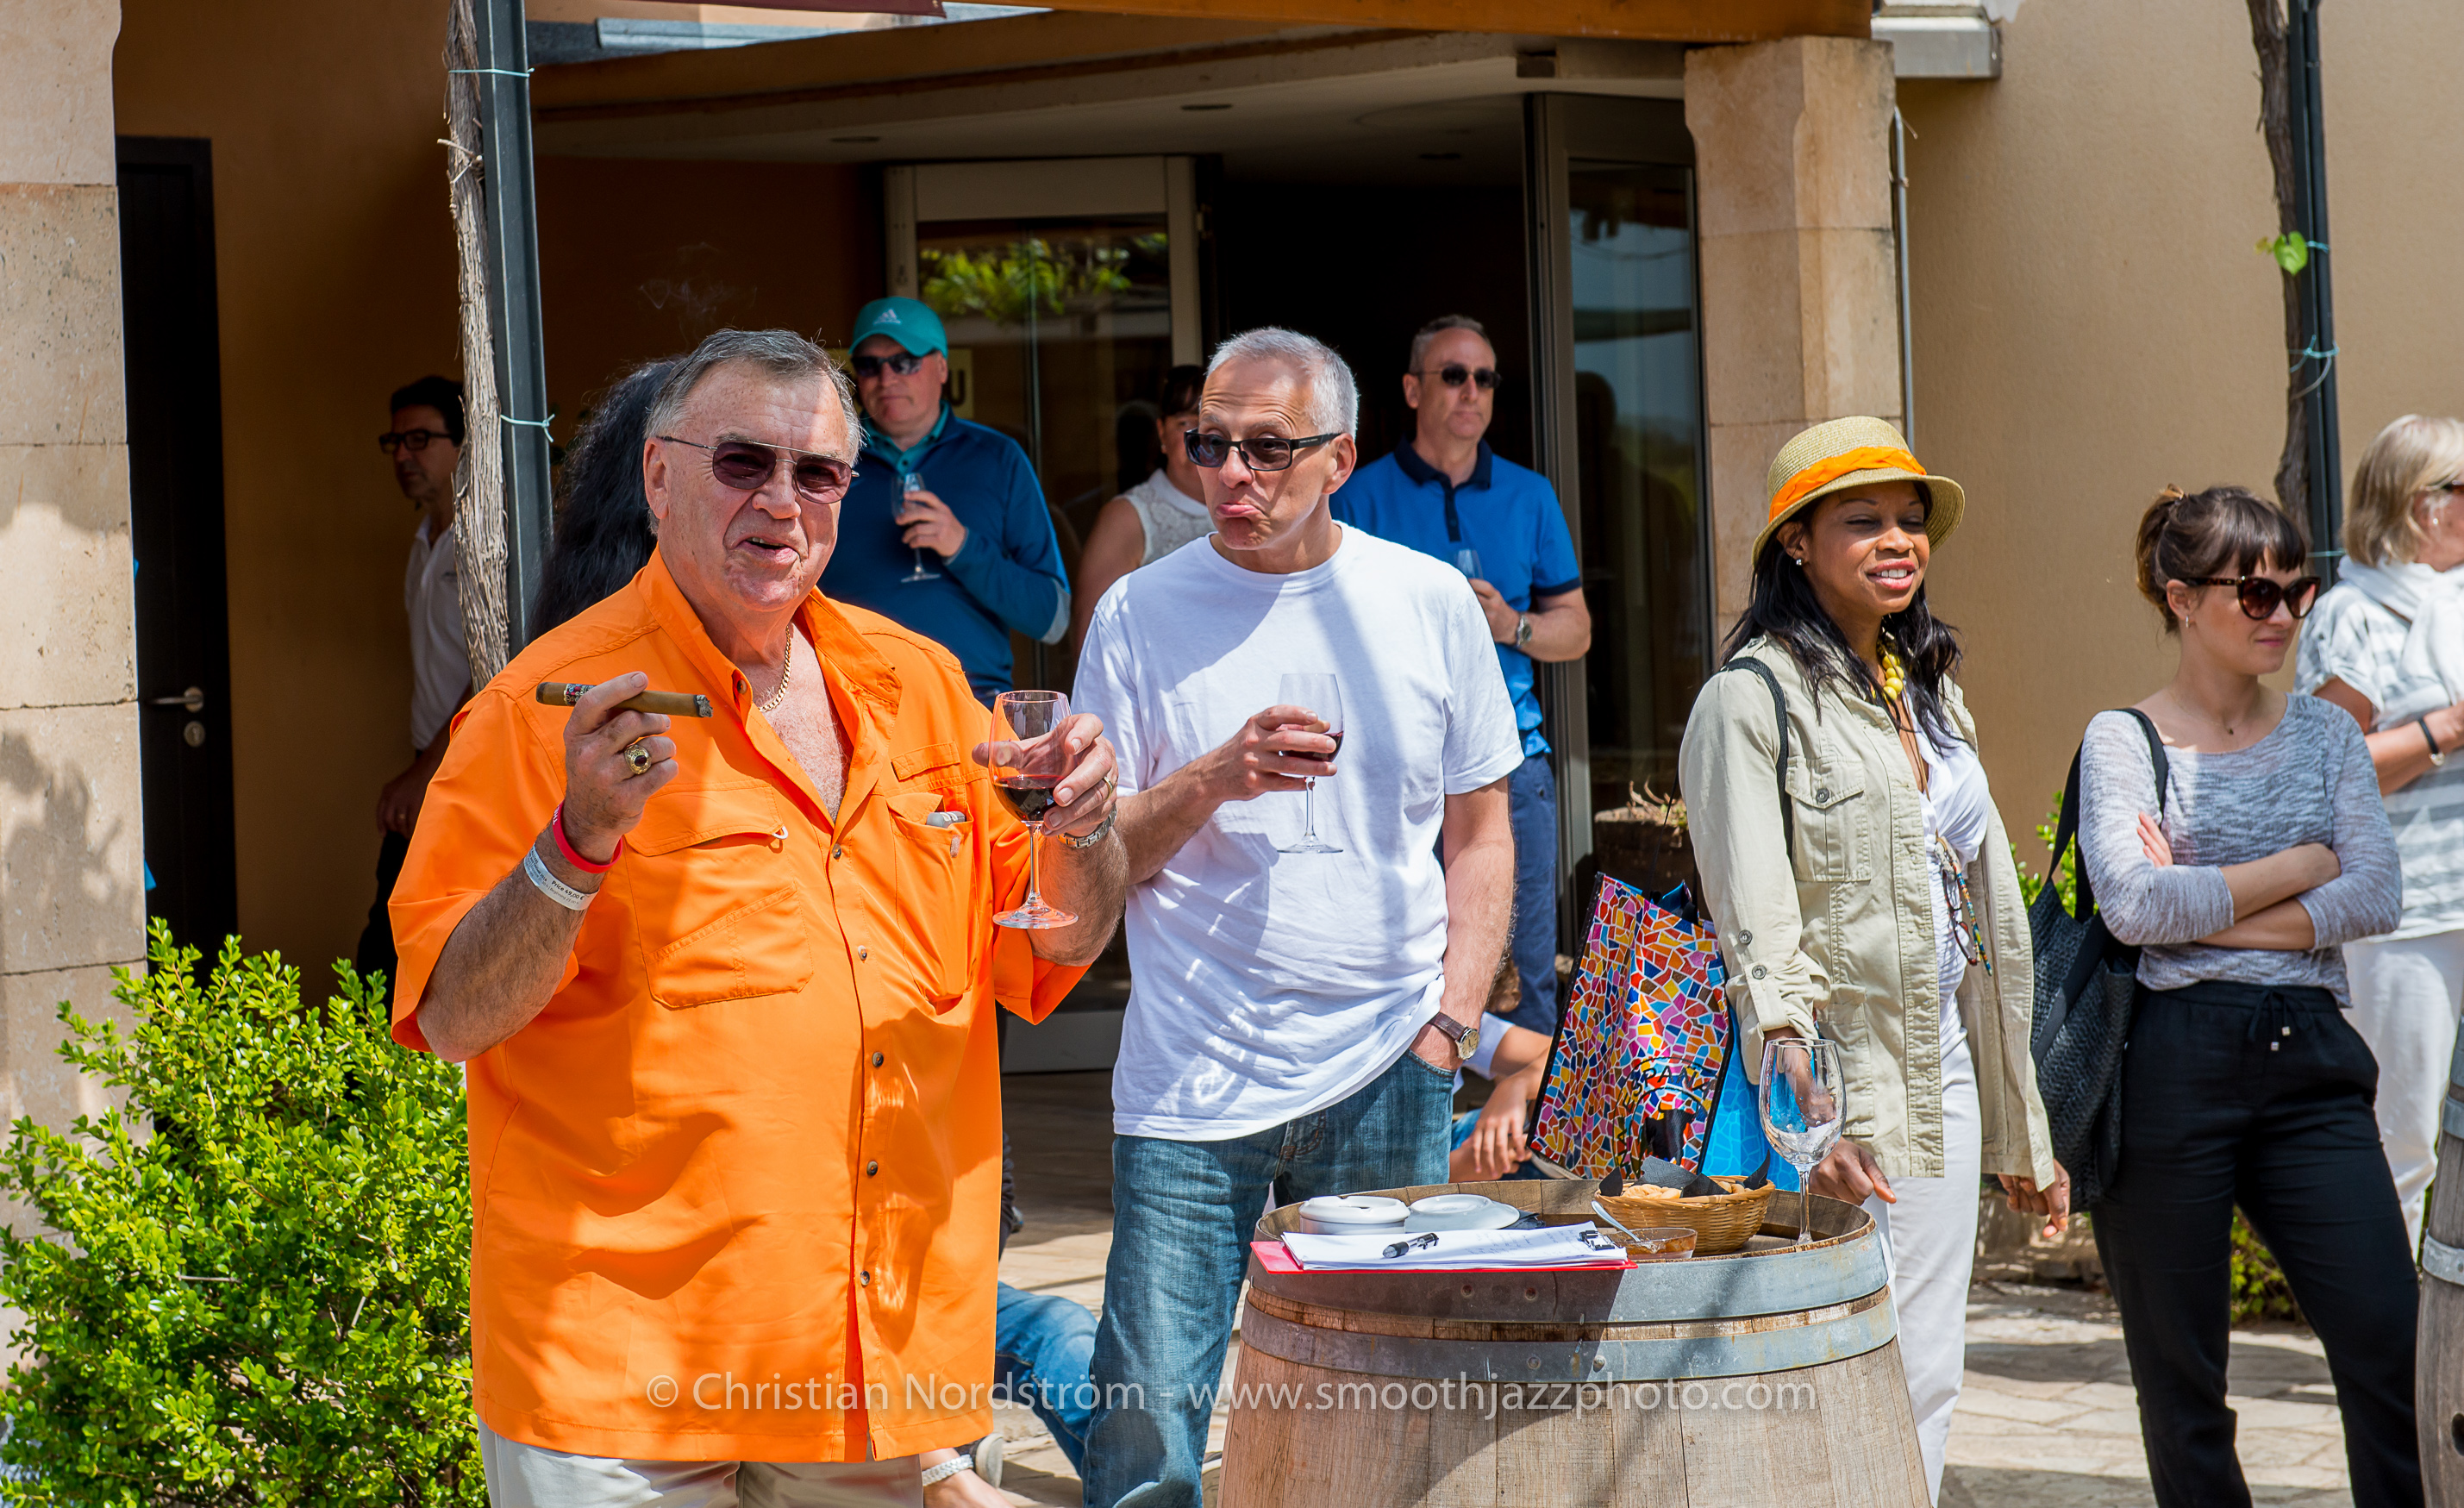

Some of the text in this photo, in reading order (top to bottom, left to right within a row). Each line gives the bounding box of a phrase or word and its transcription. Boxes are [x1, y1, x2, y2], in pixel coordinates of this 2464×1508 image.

[552, 880, 565, 892] Price
[565, 889, 580, 899] 49,00
[1622, 1064, 1714, 1114] ESPAÑA
